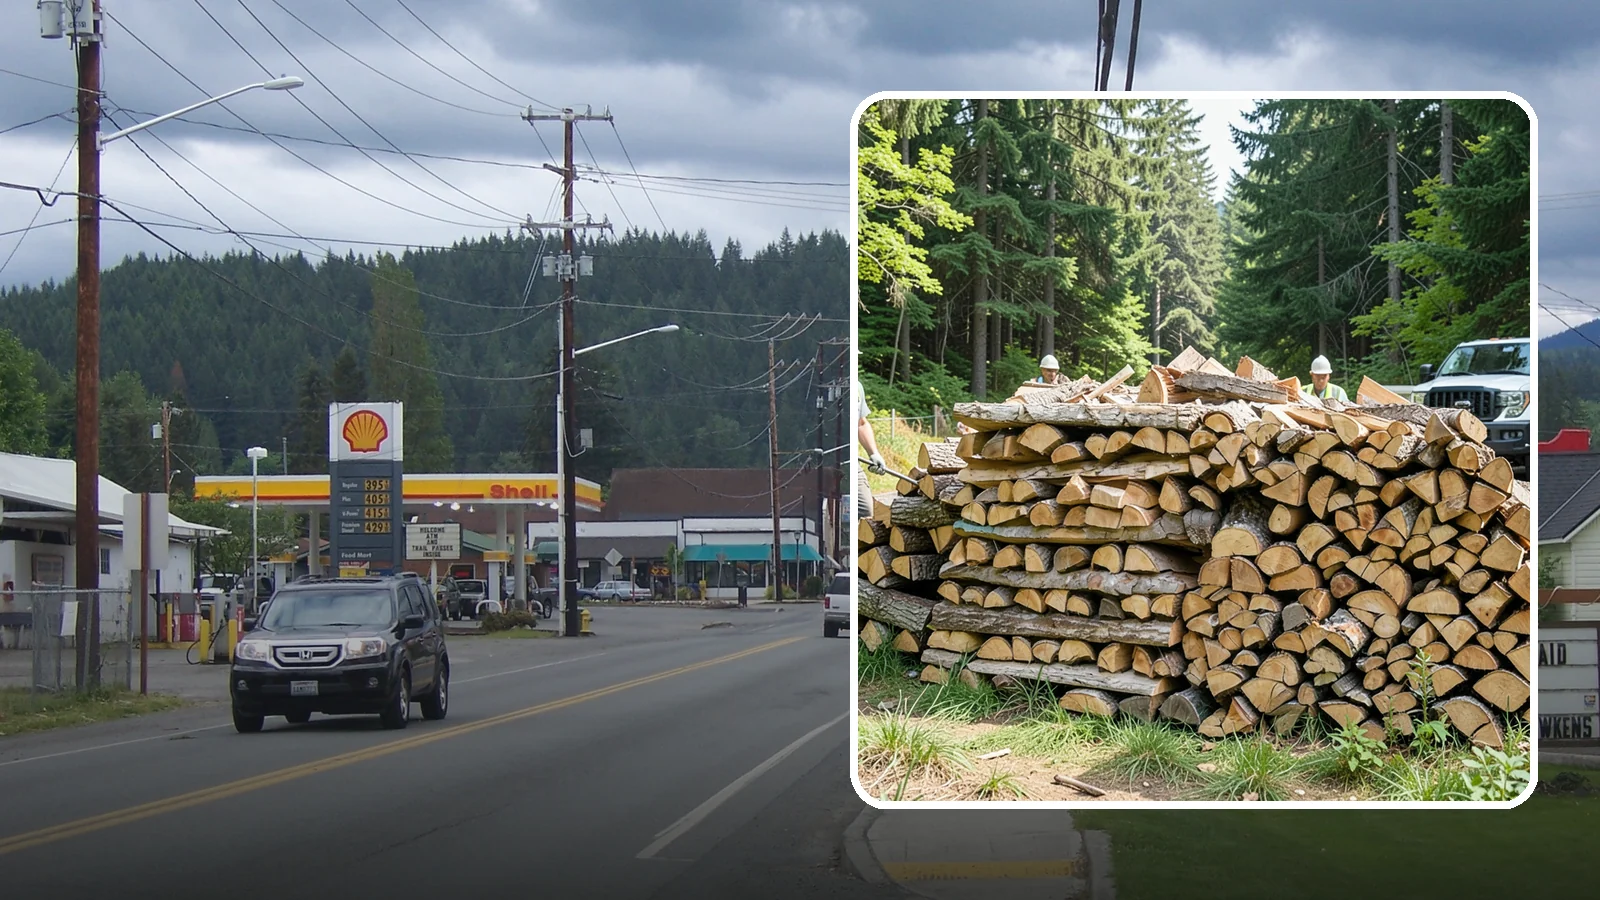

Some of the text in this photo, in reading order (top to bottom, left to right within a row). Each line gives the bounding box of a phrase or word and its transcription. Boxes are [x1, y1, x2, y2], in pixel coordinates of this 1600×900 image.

[366, 480, 383, 490] 395
[490, 484, 547, 499] Shell
[366, 494, 383, 504] 405
[366, 508, 383, 518] 415
[366, 522, 383, 532] 429
[1538, 643, 1567, 666] AID
[1538, 716, 1592, 738] WKENS
